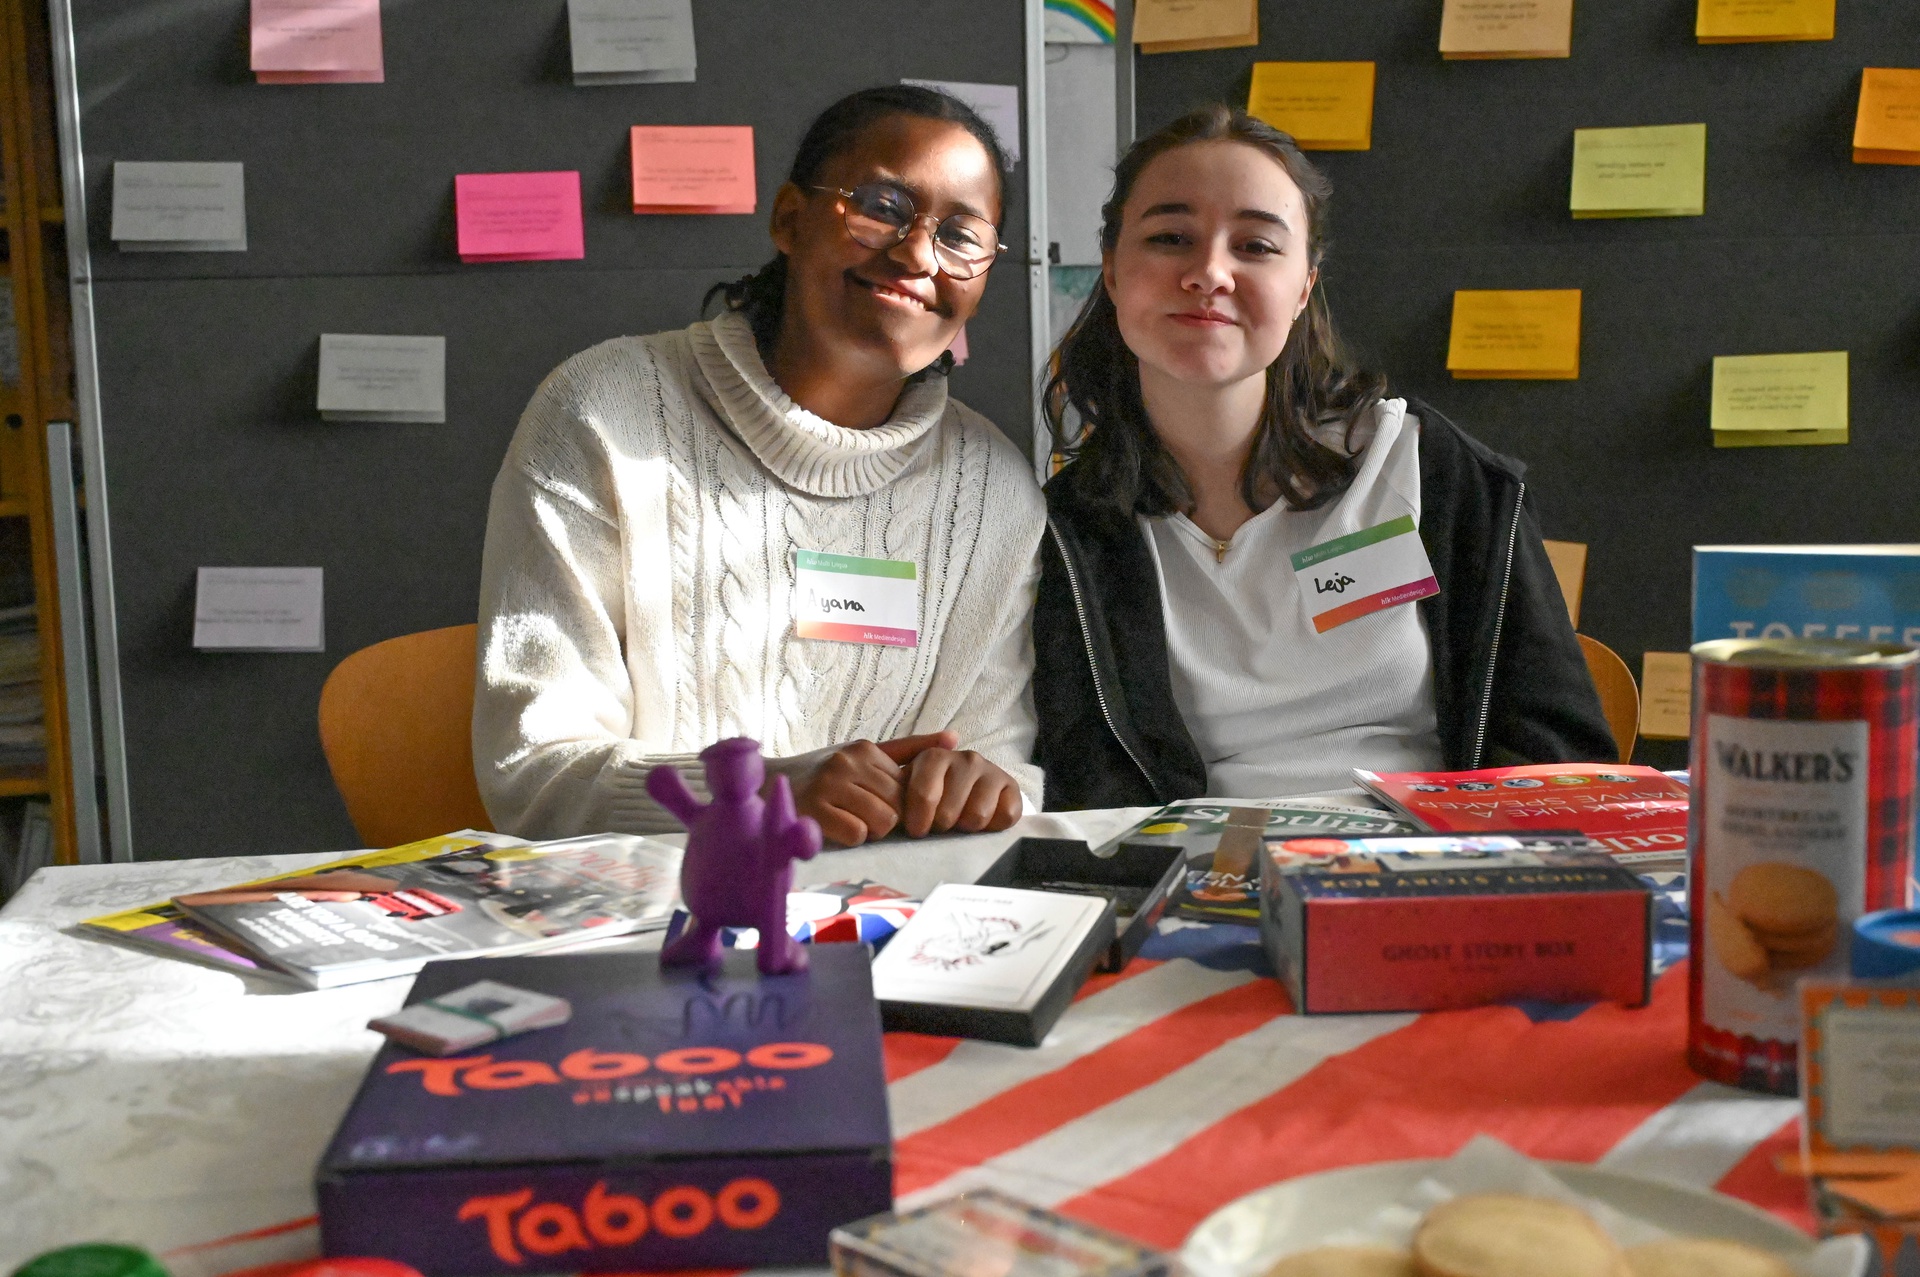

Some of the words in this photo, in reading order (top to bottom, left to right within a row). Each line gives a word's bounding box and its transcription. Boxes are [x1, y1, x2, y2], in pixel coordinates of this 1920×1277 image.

[1314, 572, 1355, 594] Leja
[1391, 587, 1427, 602] Mediendesign
[873, 633, 906, 644] Mediendesign
[1416, 796, 1567, 809] SPEAKER
[1582, 800, 1665, 813] TALK
[1469, 810, 1493, 819] A
[1505, 806, 1577, 817] LIKE
[1382, 943, 1451, 961] GHOST
[1535, 940, 1576, 956] BOX
[386, 1042, 834, 1097] Taboo
[457, 1177, 781, 1265] Taboo
